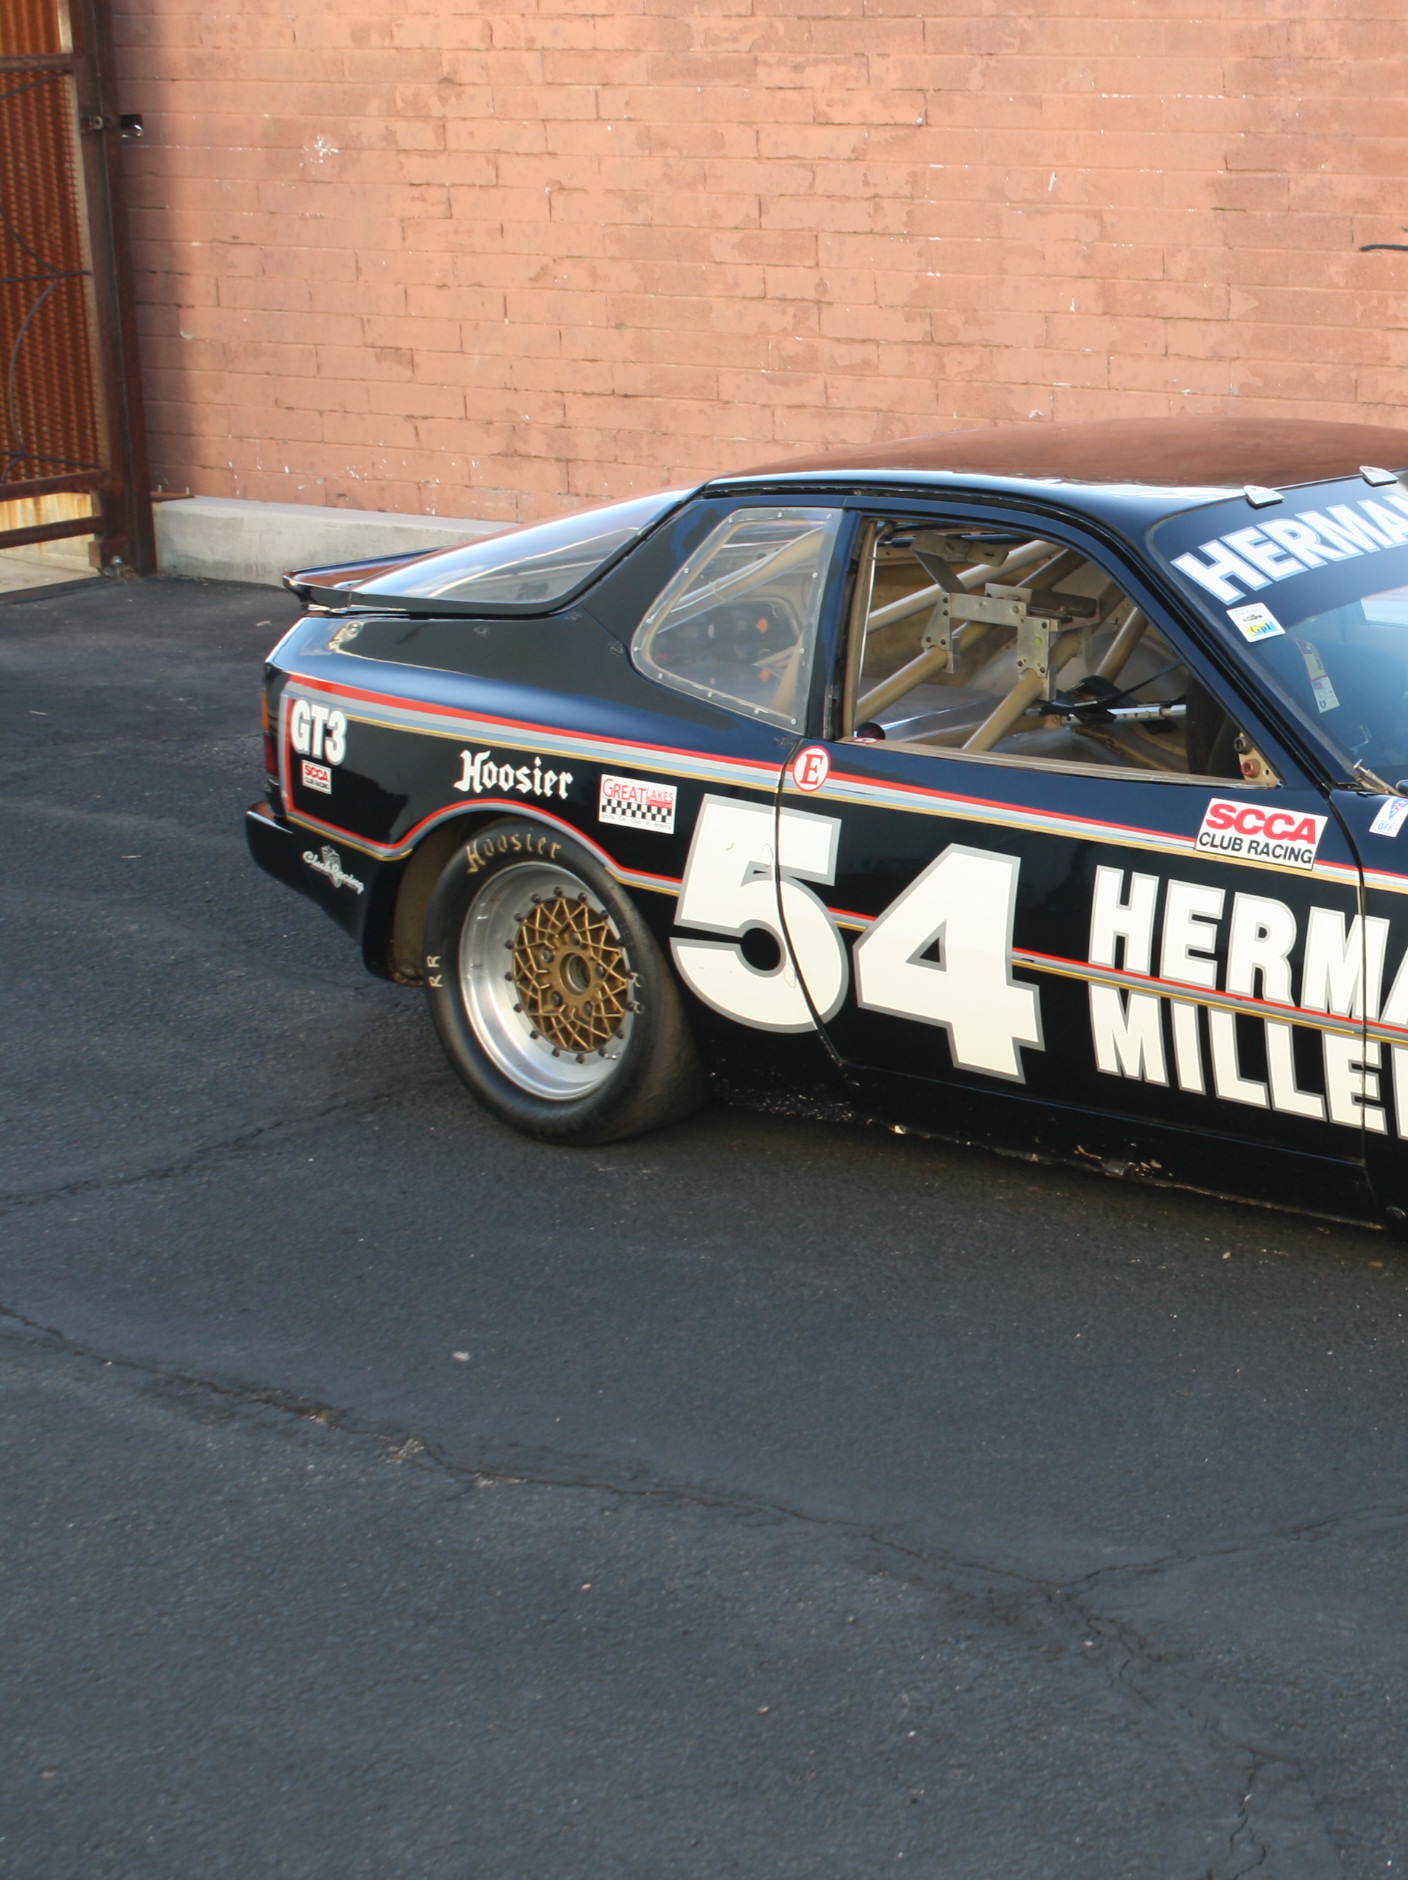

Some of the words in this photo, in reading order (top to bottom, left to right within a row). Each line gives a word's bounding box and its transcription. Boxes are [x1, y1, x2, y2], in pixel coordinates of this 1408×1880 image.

[291, 699, 347, 766] GT3
[305, 764, 328, 782] SCCA
[453, 750, 574, 799] Hoosier
[799, 752, 826, 787] E
[602, 778, 648, 804] GREAT
[645, 789, 675, 804] LAKES
[1206, 803, 1317, 845] SCCA
[1377, 822, 1395, 832] OFF
[466, 834, 562, 874] Hoosier
[1199, 831, 1243, 852] CLUB
[1247, 839, 1314, 865] RACING
[670, 794, 1046, 1084] 54
